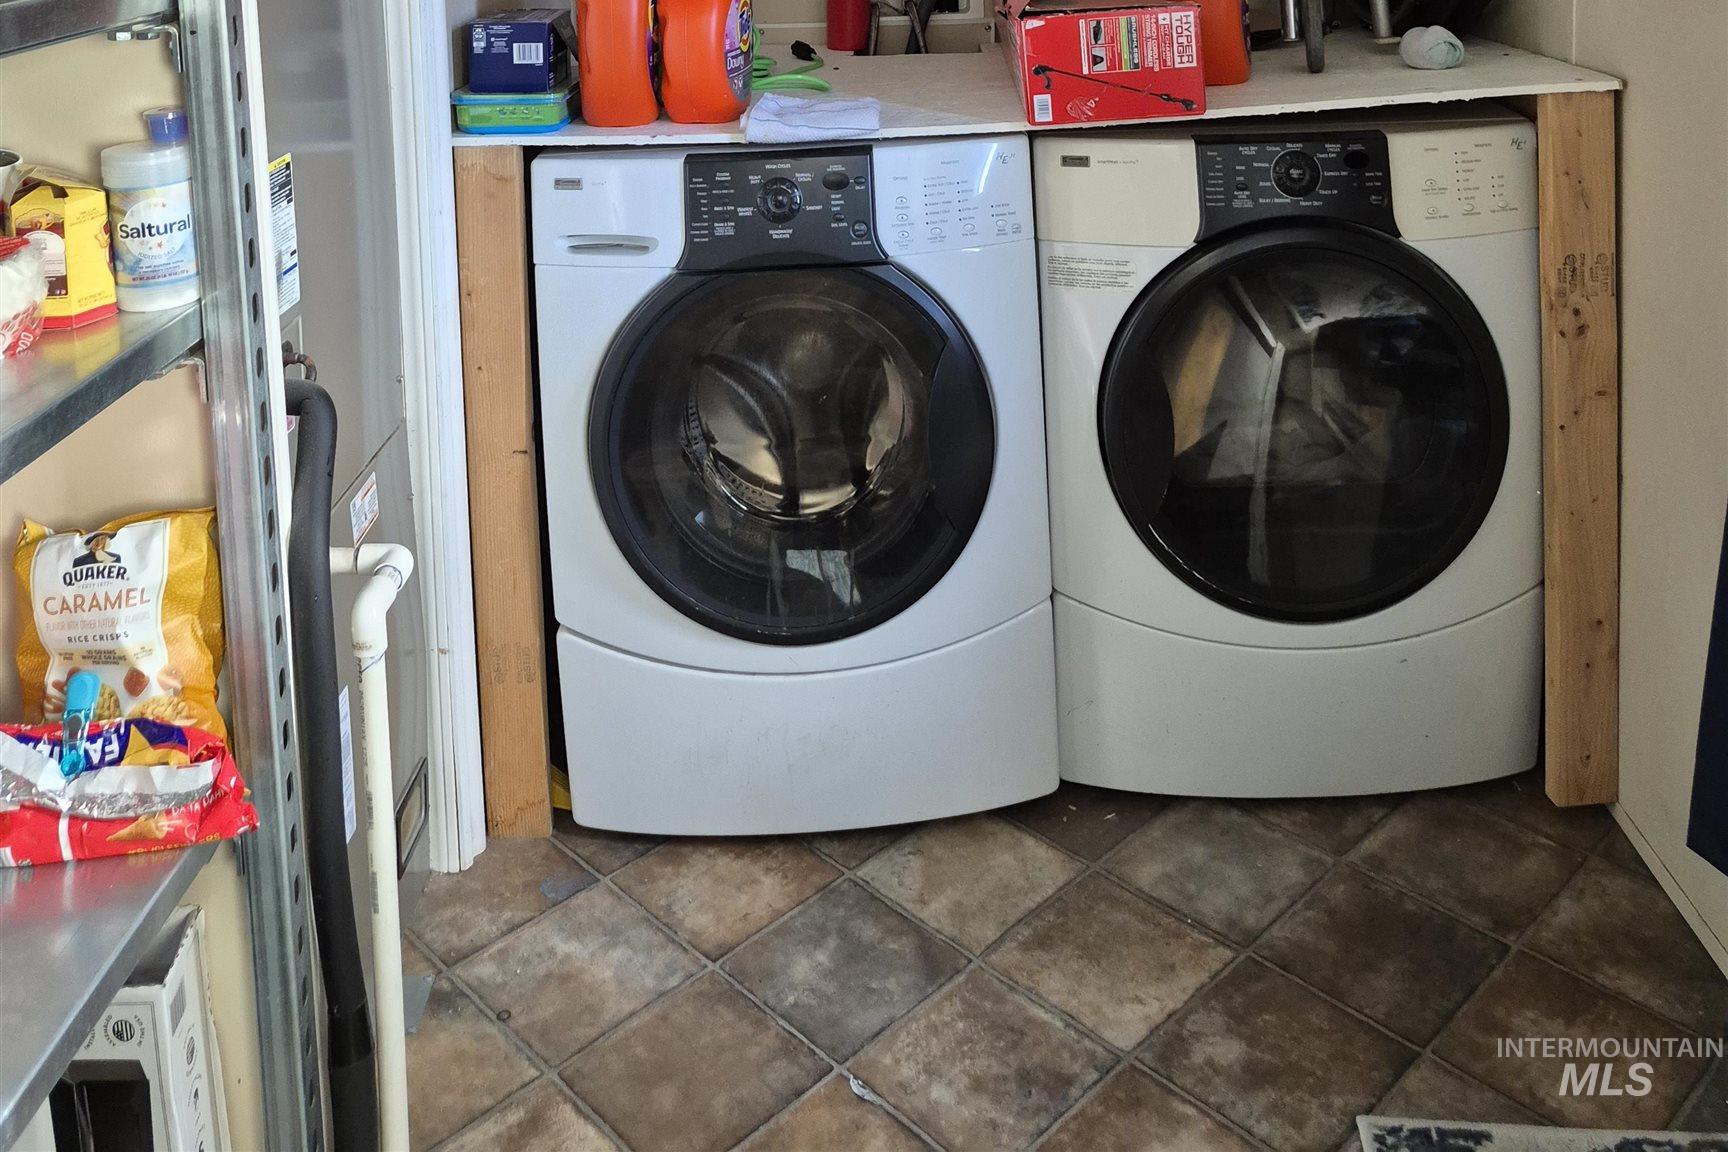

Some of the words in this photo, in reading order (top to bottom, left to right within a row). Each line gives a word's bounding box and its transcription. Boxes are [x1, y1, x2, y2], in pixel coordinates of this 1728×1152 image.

[1131, 16, 1139, 64] BRUSHLESS
[1175, 15, 1186, 65] TOUGH
[1183, 14, 1194, 64] HYPER
[119, 213, 191, 239] Saltural
[63, 565, 128, 587] QUAKER
[43, 587, 151, 616] CARAMEL
[67, 634, 90, 644] RICE
[92, 631, 129, 642] CRISPS
